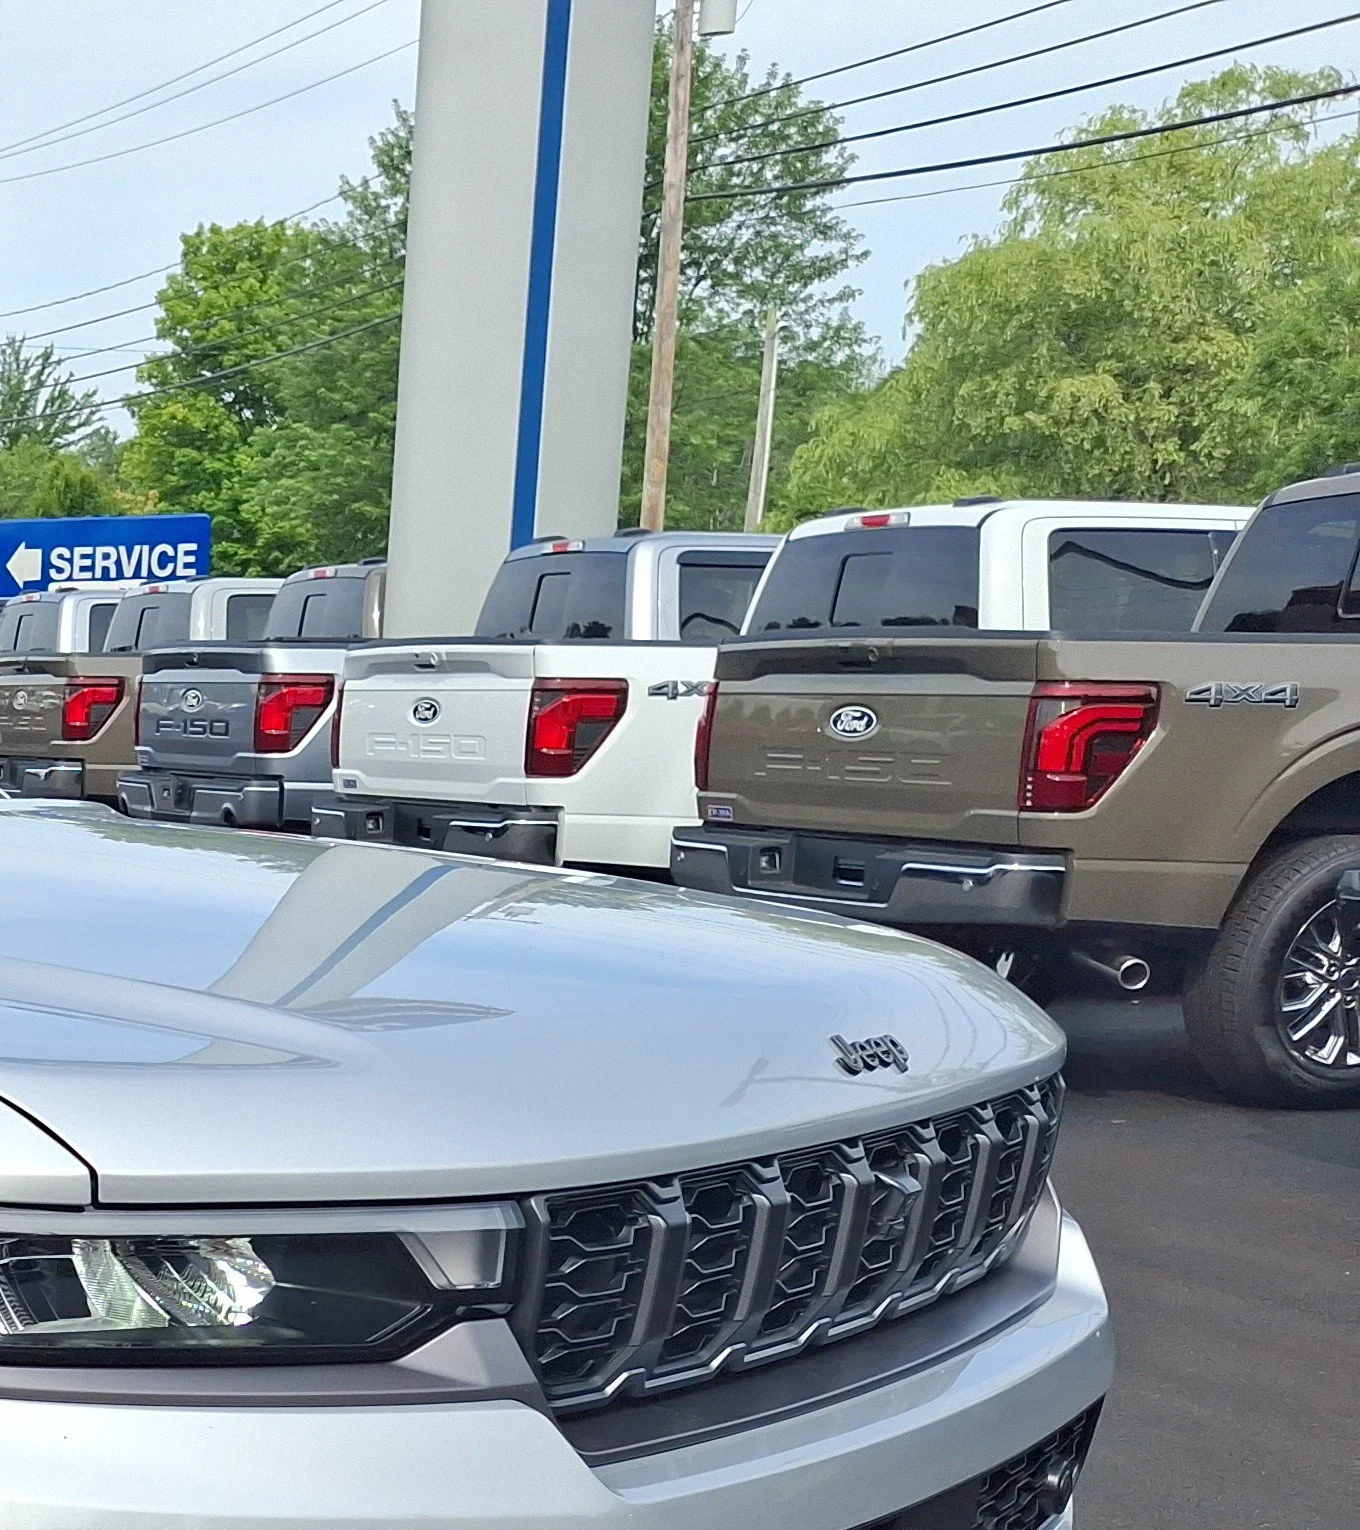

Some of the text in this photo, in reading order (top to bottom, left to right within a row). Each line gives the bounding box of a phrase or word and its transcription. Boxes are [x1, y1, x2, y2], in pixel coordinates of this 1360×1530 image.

[47, 542, 199, 580] SERVICE
[648, 681, 708, 700] 4X
[1185, 682, 1299, 709] 4X4
[155, 719, 230, 738] F-150
[836, 711, 869, 731] Ford
[366, 732, 486, 760] F-150
[829, 1034, 909, 1076] Jeep
